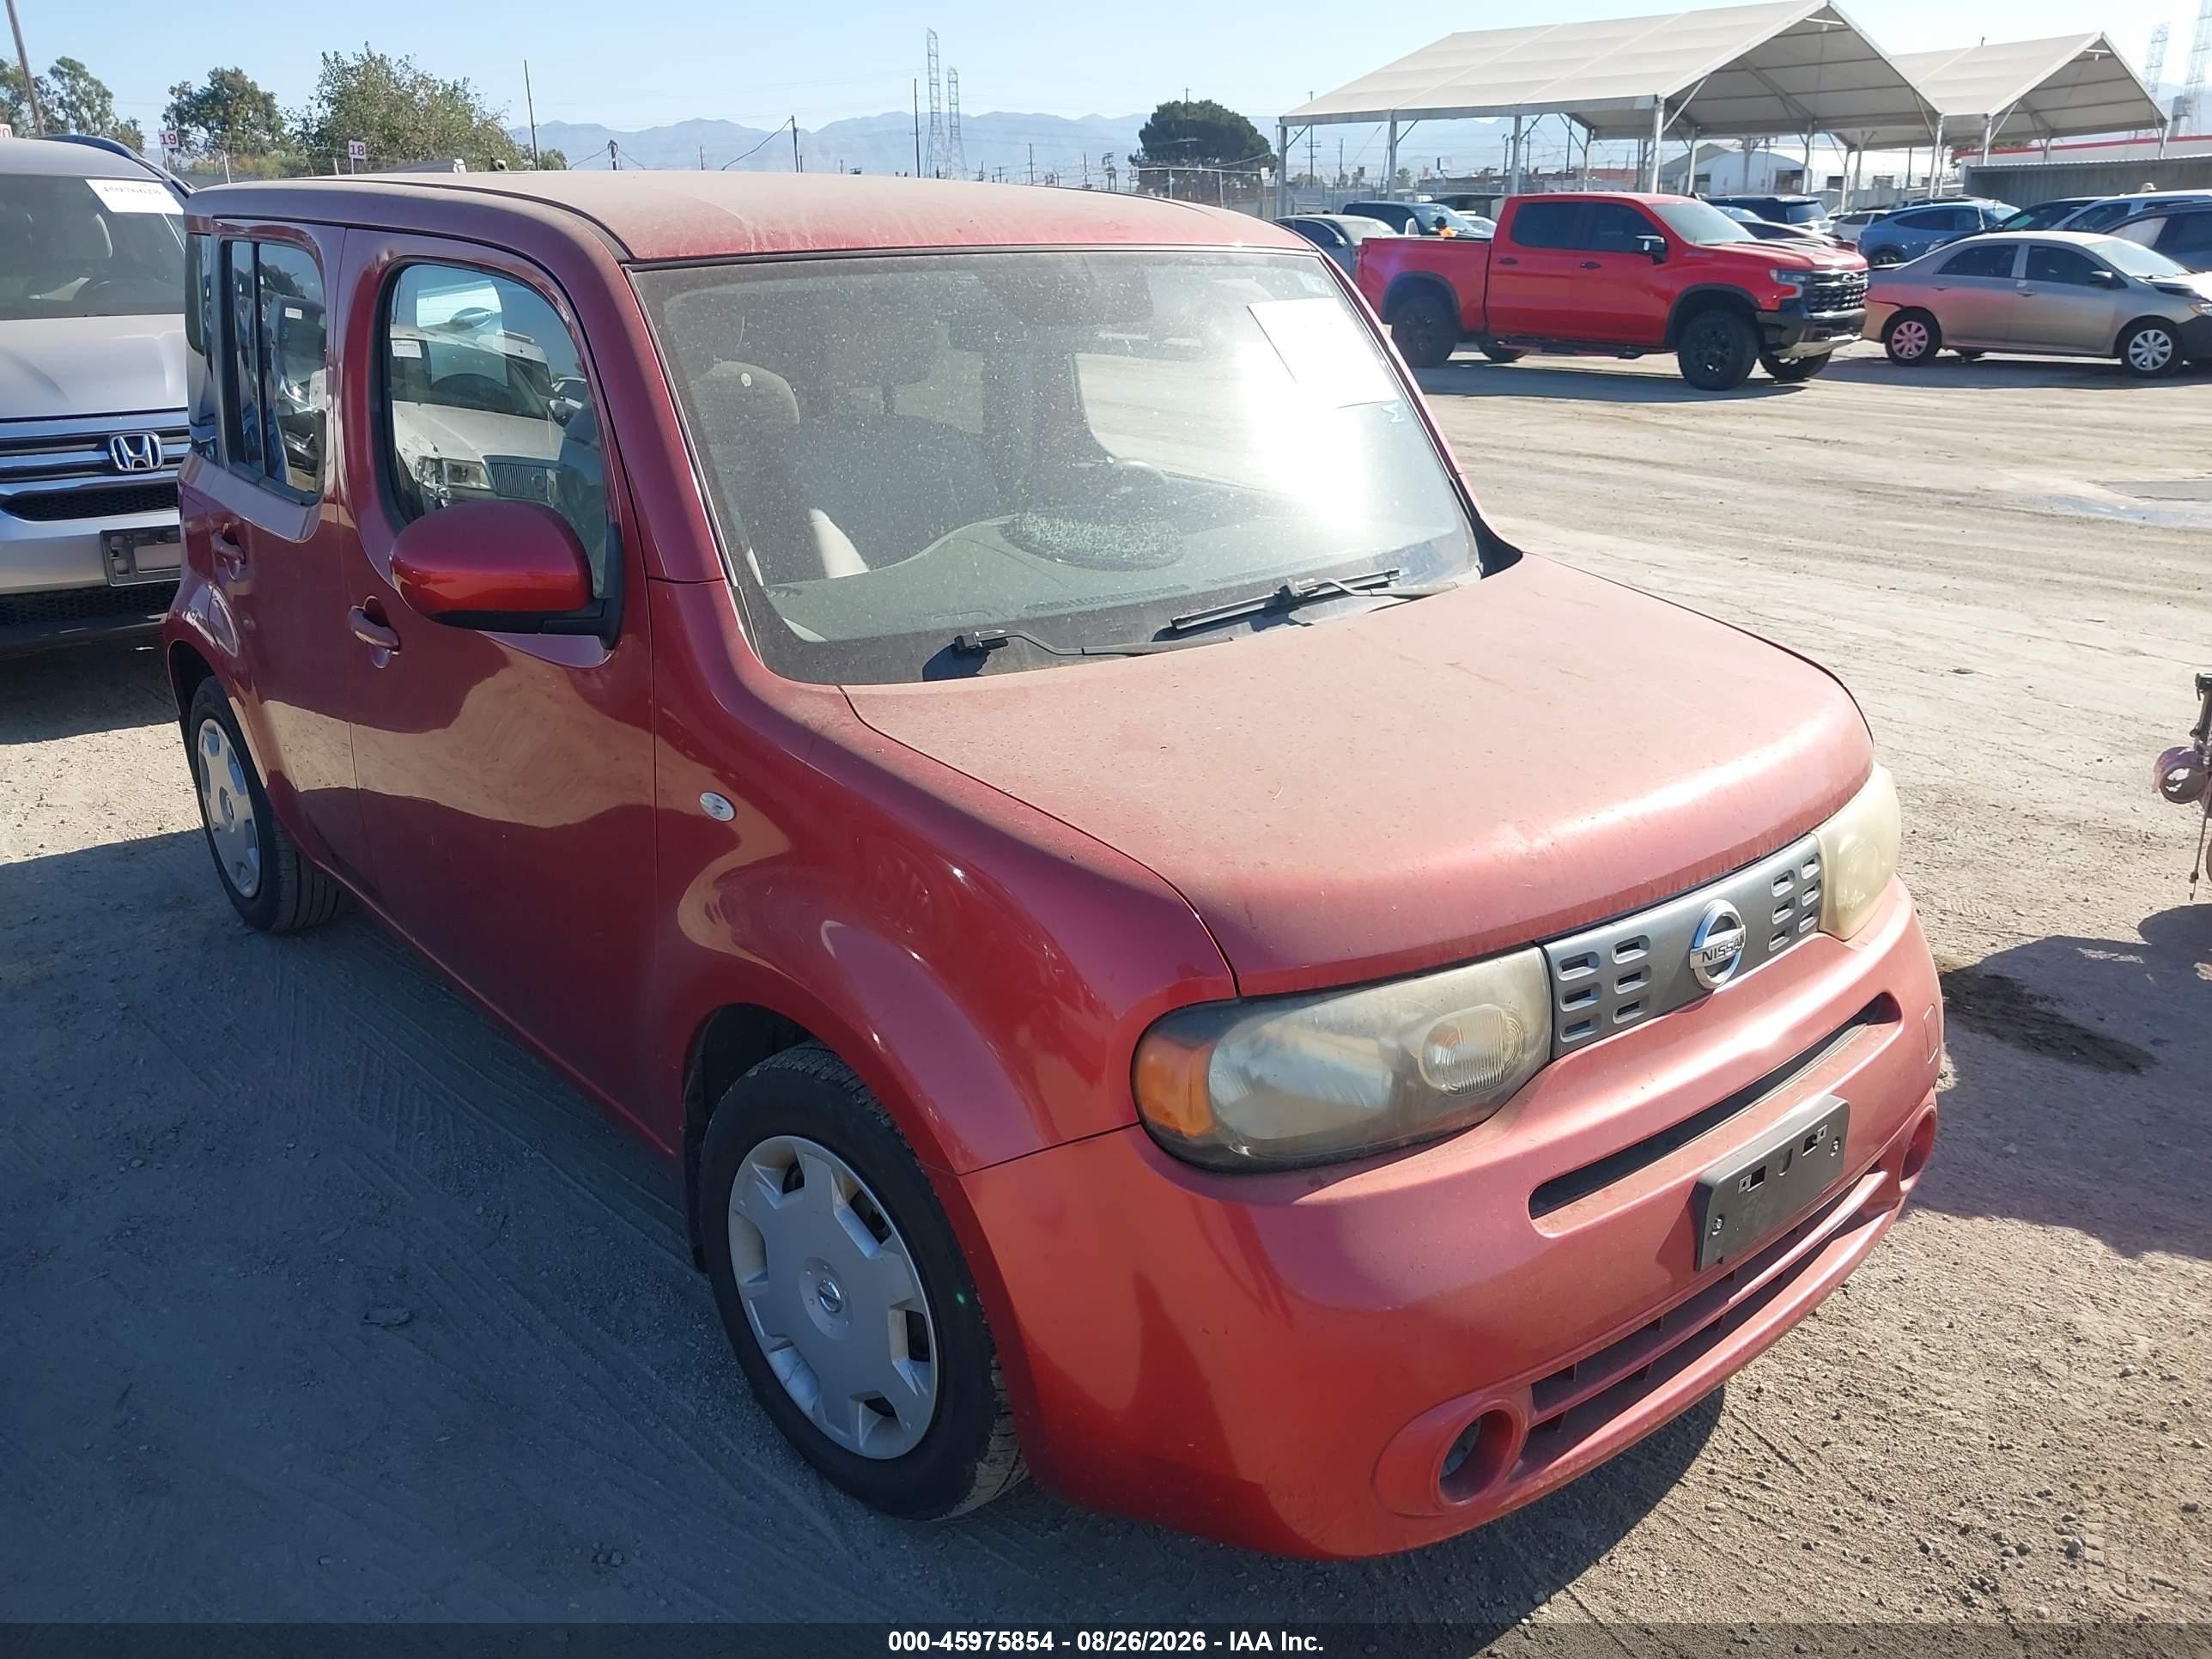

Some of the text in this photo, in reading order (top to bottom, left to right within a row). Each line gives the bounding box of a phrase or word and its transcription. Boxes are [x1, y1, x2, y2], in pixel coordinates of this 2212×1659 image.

[159, 133, 177, 145] 19
[349, 144, 365, 156] 18
[1701, 933, 1745, 963] NISSAN
